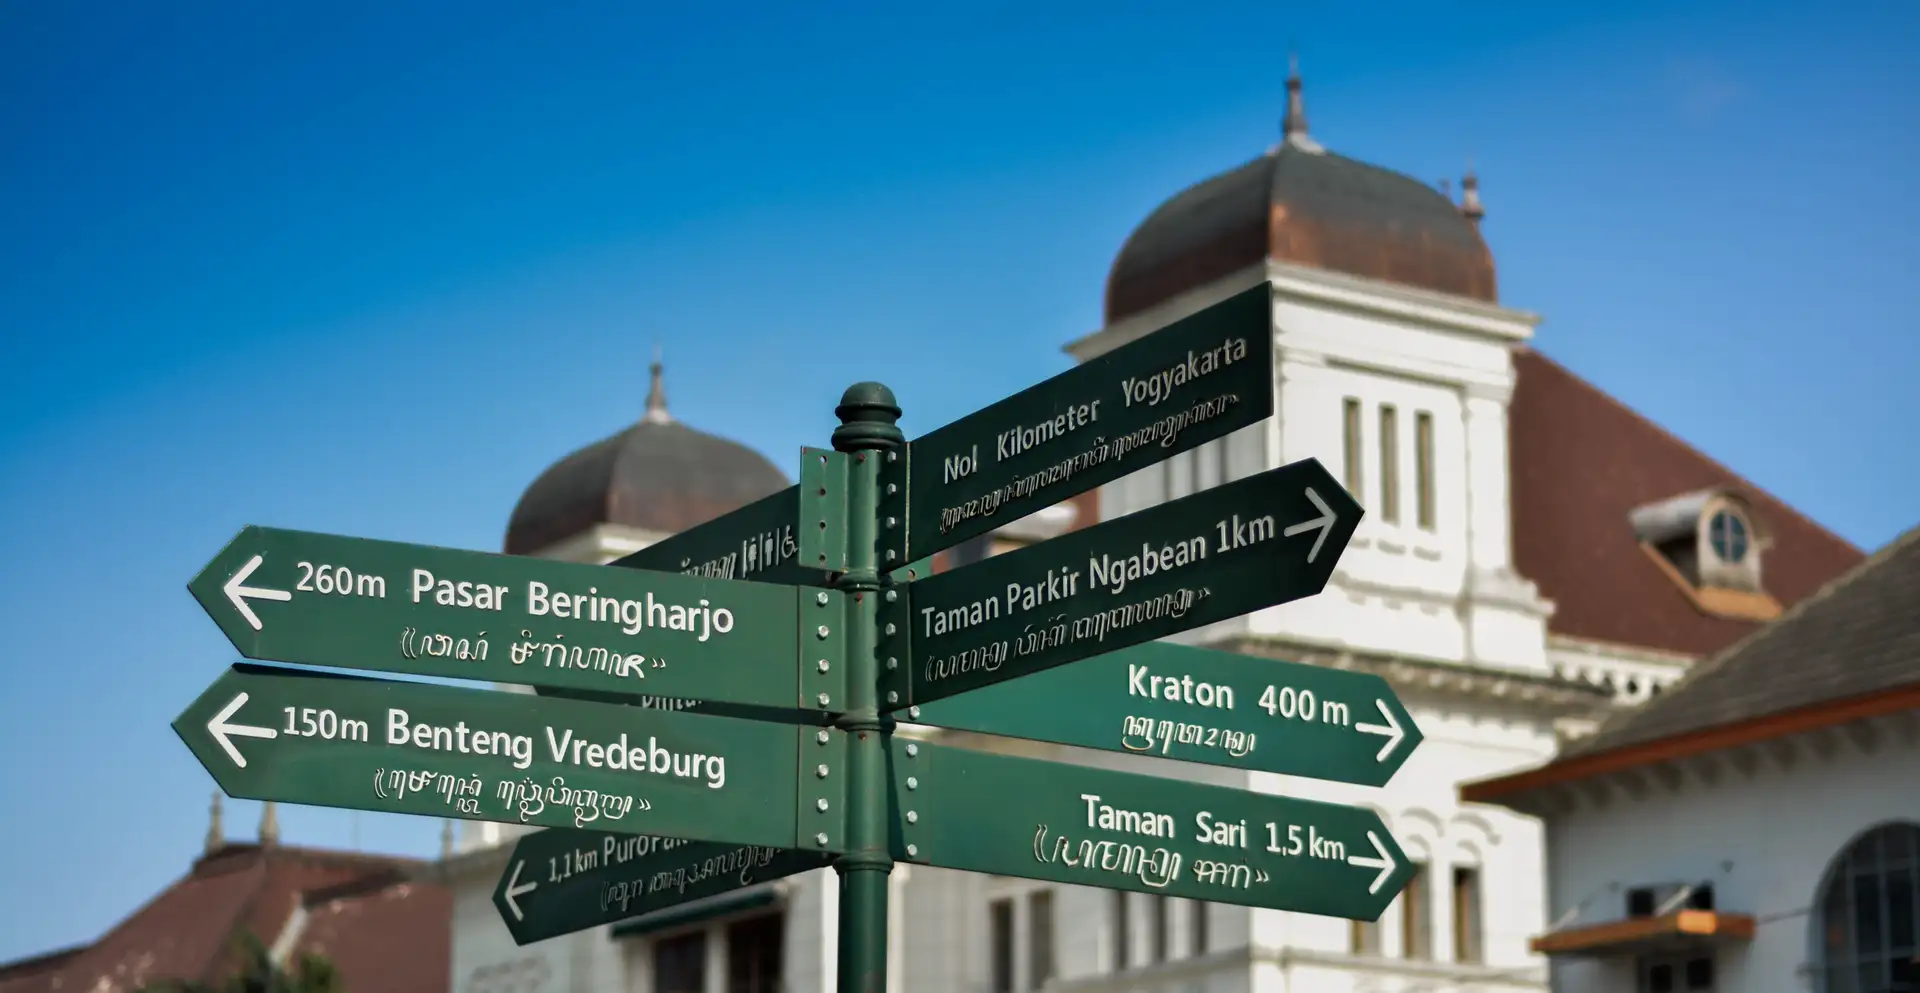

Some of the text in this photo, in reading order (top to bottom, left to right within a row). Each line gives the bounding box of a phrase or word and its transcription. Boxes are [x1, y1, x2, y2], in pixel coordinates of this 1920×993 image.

[943, 443, 979, 485] Nol
[996, 398, 1101, 463] Kilometer
[1120, 337, 1247, 408] Yogyakarta
[295, 561, 735, 643] 260m Pasar Beringharjo
[920, 596, 1000, 639] Taman
[1006, 566, 1081, 616] Parkir
[1088, 536, 1207, 596] Ngabean
[1215, 513, 1276, 554] 1km
[1128, 663, 1234, 710] Kraton
[282, 705, 727, 789] 150m Benteng Vredeburg
[1079, 793, 1176, 840] Taman
[1195, 811, 1248, 849] Sari
